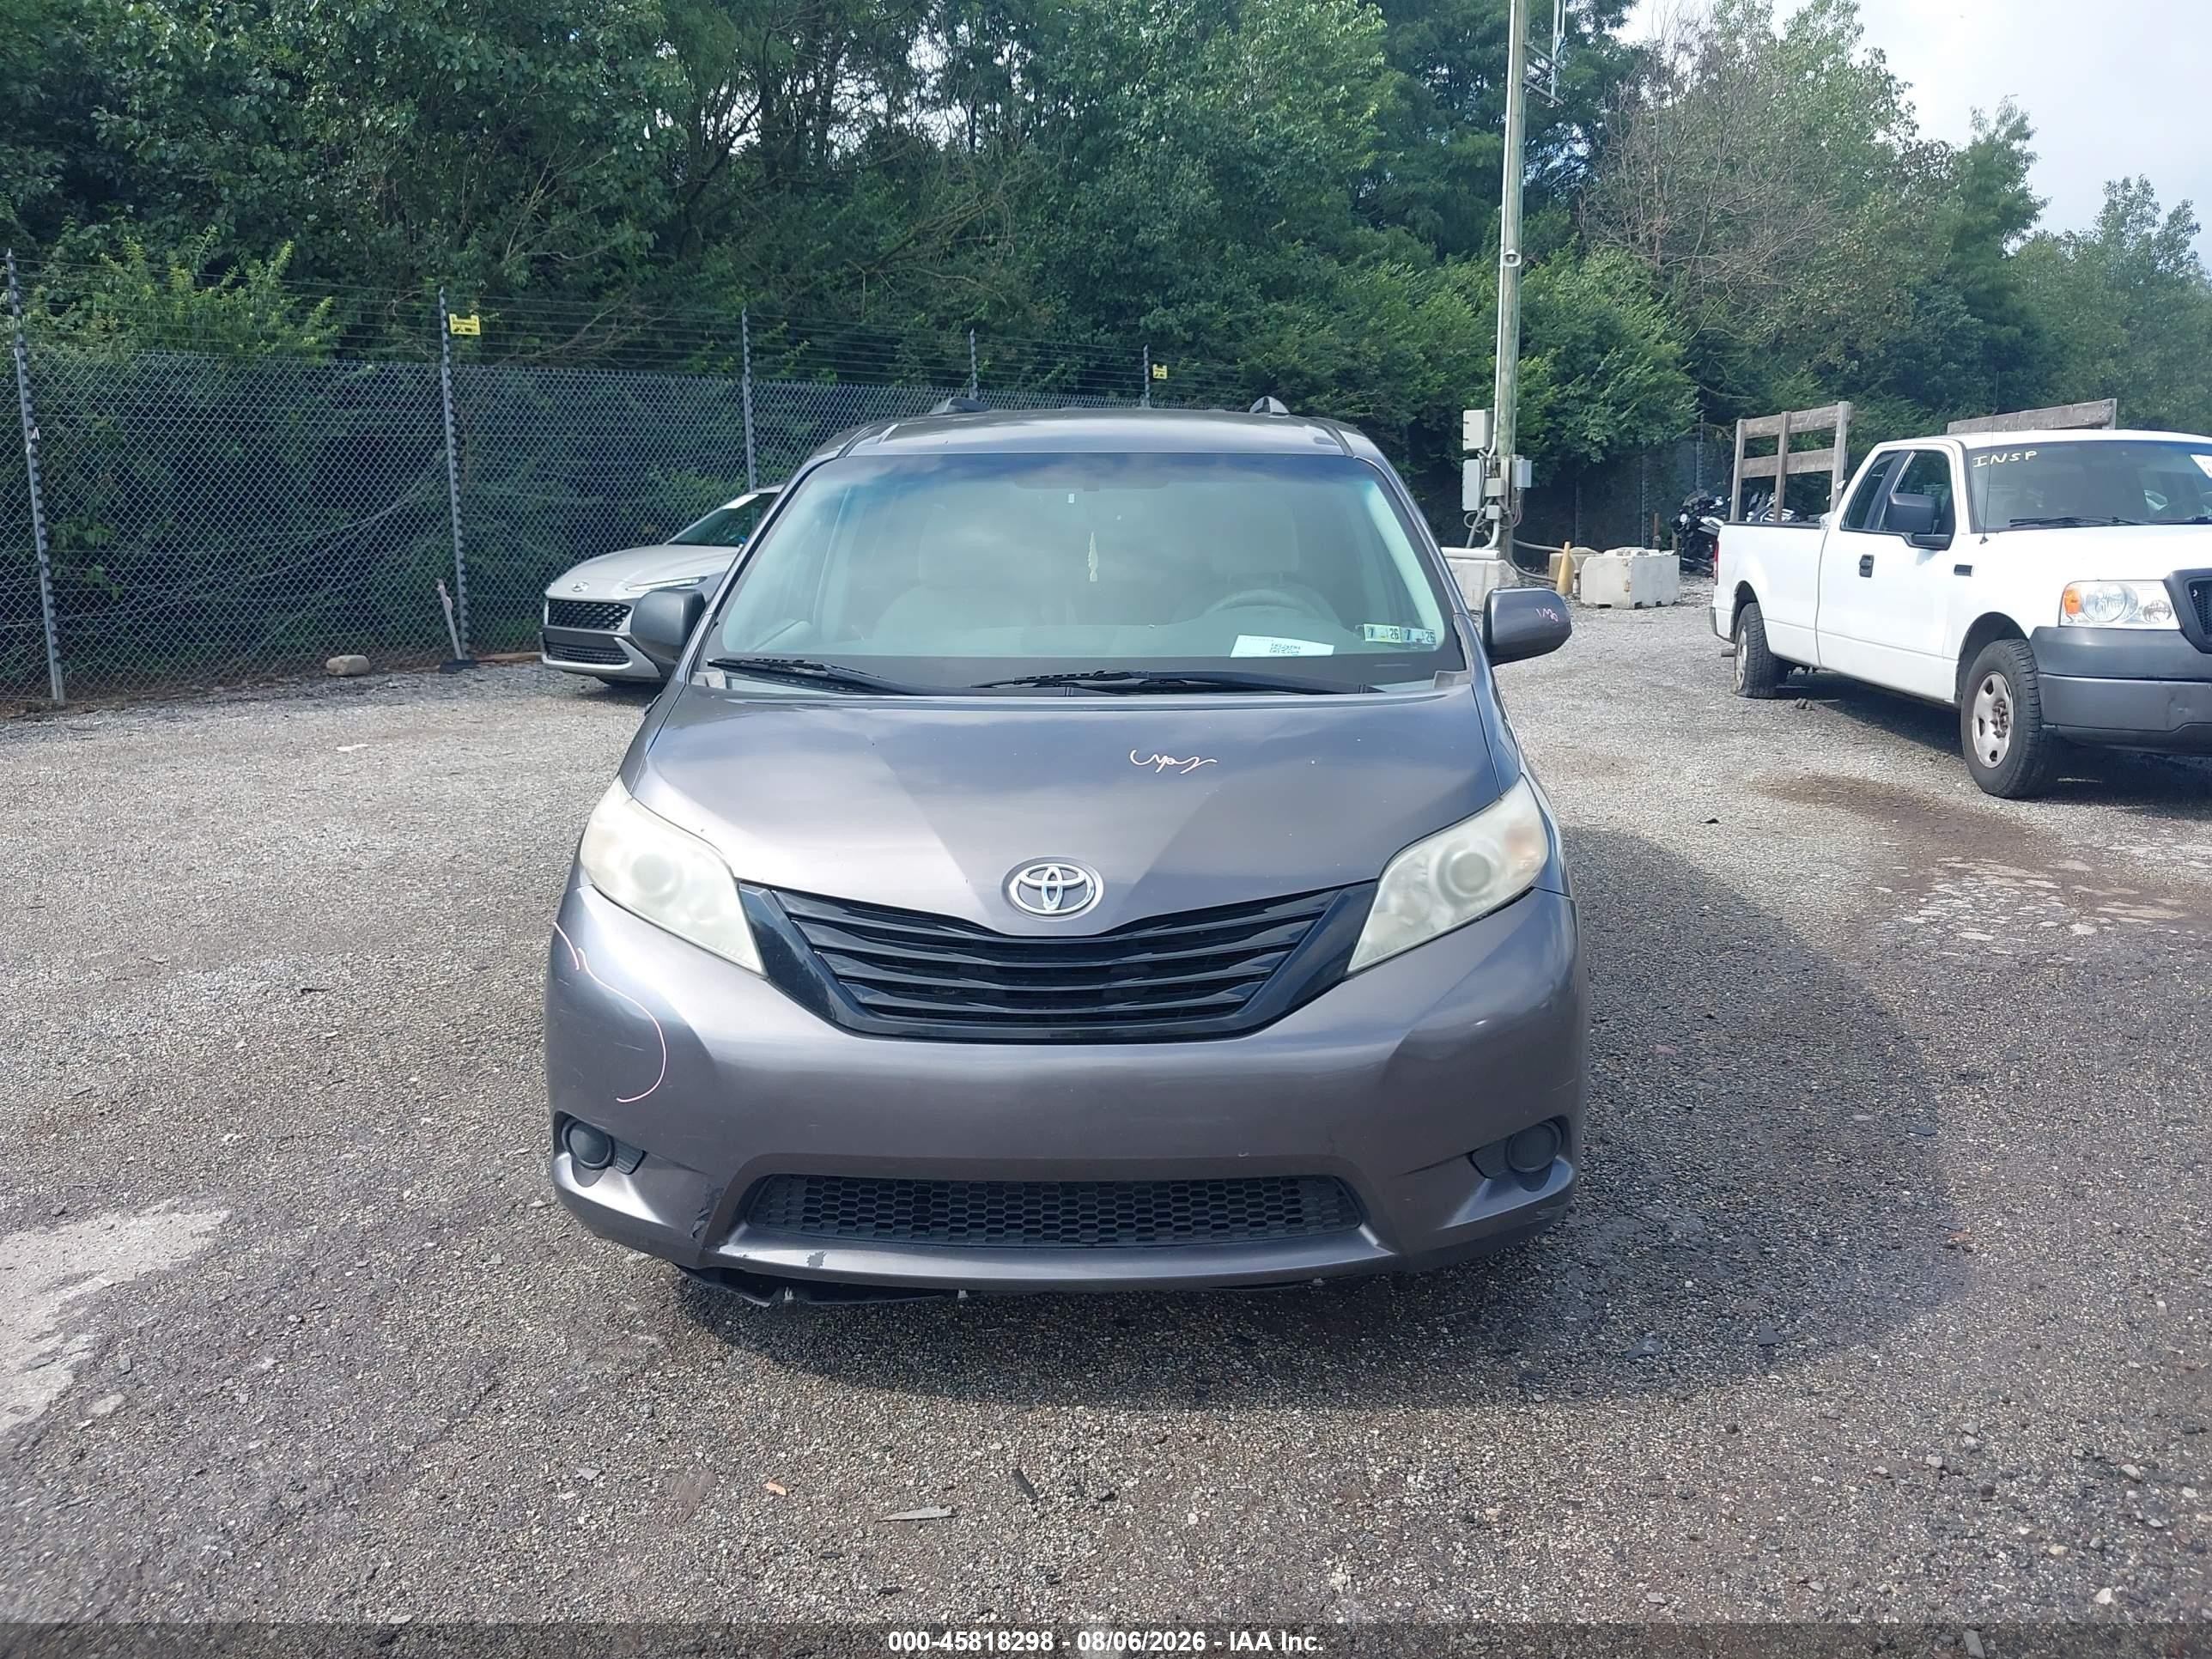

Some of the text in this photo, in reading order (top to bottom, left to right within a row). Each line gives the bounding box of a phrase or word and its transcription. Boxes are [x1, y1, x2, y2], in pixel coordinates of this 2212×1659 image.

[1972, 451, 2038, 468] INSP
[1389, 628, 1400, 640] 26
[1425, 631, 1436, 642] 26
